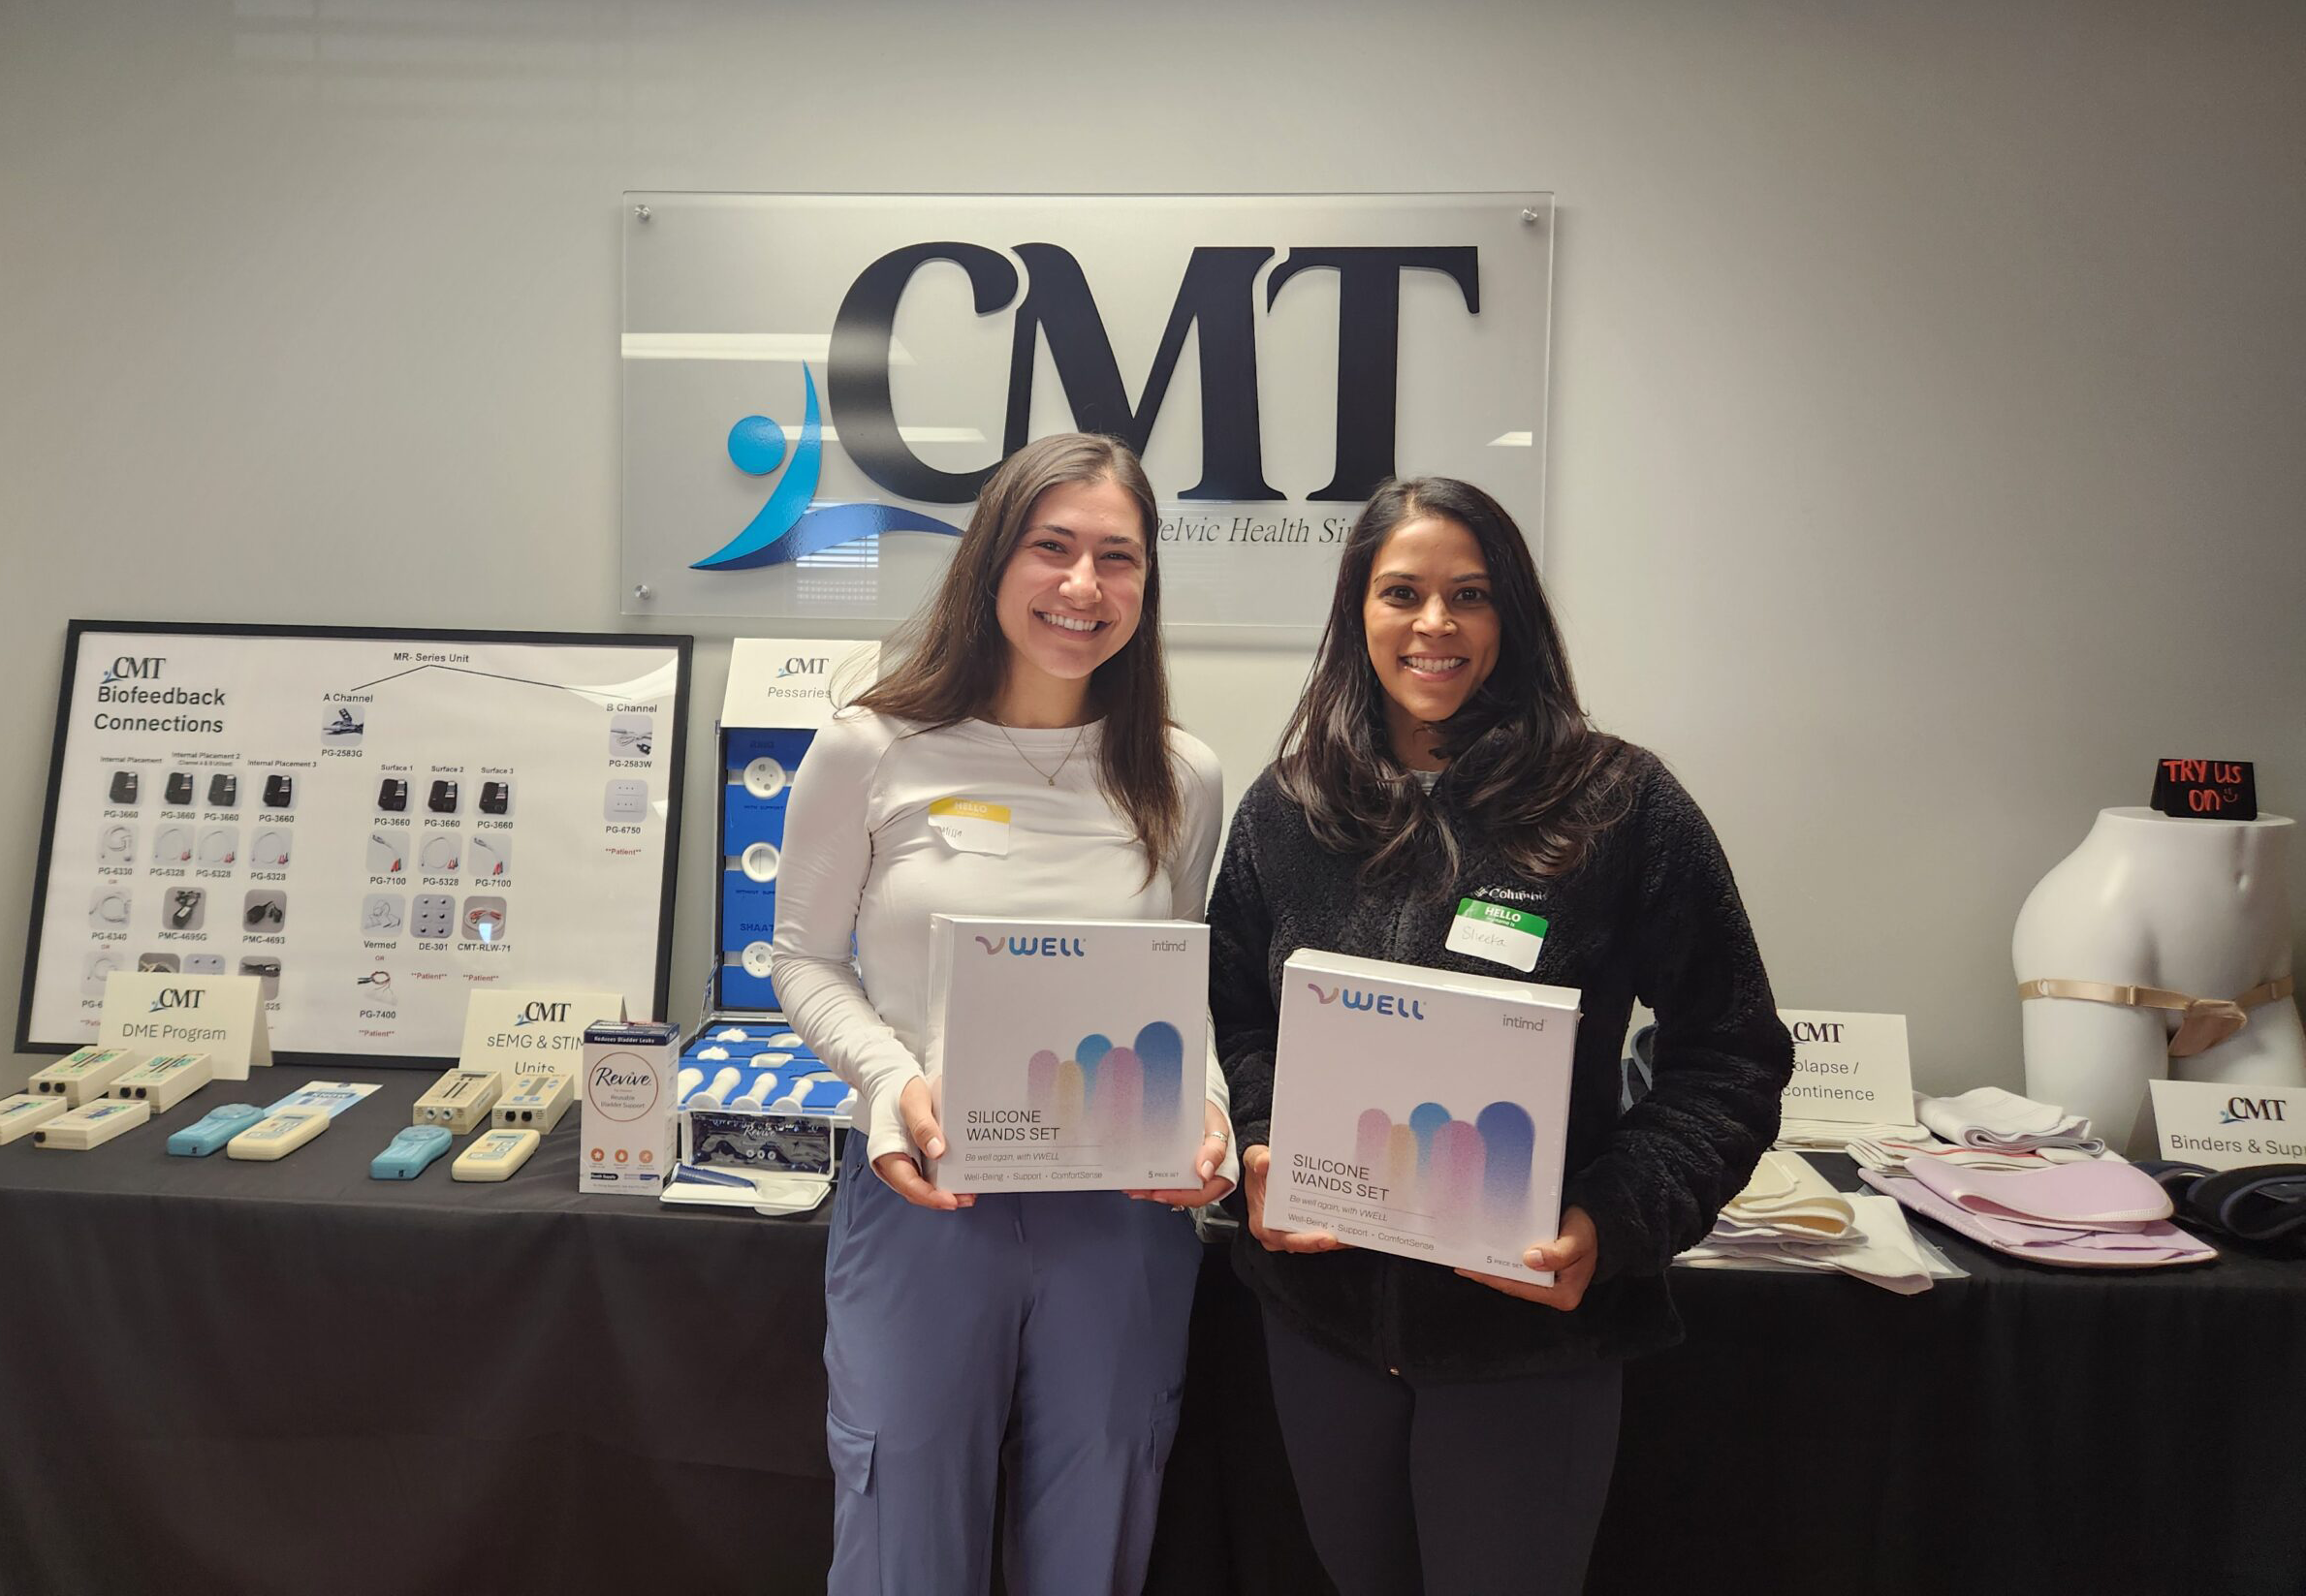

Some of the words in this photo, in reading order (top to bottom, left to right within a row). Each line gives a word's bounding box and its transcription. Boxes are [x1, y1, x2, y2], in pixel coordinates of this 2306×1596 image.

[827, 241, 1480, 502] CMT
[1227, 517, 1310, 543] Health
[1319, 517, 1352, 543] Si
[416, 653, 446, 663] Series
[449, 653, 469, 664] Unit
[785, 657, 830, 674] CMT
[112, 657, 166, 678] CMT
[97, 685, 226, 705] Biofeedback
[323, 693, 331, 703] A
[332, 693, 374, 704] Channel
[768, 686, 831, 699] Pessaries
[606, 704, 614, 712] B
[616, 704, 658, 713] Channel
[94, 713, 223, 733] Connections
[321, 749, 363, 759] PG-2583G
[609, 760, 652, 768] PG-2583W
[2162, 759, 2207, 783] TRY
[374, 818, 410, 827] PG-3660
[477, 821, 514, 829] PG-3660
[605, 826, 641, 834] PG-6750
[369, 876, 406, 886] PG-7100
[423, 877, 459, 887] PG-5328
[475, 879, 512, 888] PG-7100
[1484, 907, 1521, 923] HELLO
[975, 935, 1085, 956] VWELL
[1152, 939, 1186, 952] intimd
[159, 987, 205, 1009] CMT
[360, 1010, 396, 1018] PG-7400
[525, 1001, 572, 1022] CMT
[1308, 984, 1424, 1020] VWELL
[1502, 1015, 1544, 1032] intimd
[122, 1023, 159, 1038] DME
[162, 1024, 227, 1043] Program
[1793, 1021, 1845, 1043] CMT
[487, 1033, 532, 1048] sEMG
[536, 1035, 548, 1048] &
[515, 1061, 555, 1076] Units
[1794, 1059, 1848, 1075] olapse
[1853, 1062, 1859, 1075] /
[595, 1067, 651, 1086] Revive
[1783, 1085, 1875, 1101] continence
[2227, 1096, 2287, 1121] CMT
[967, 1110, 1041, 1124] SILICONE
[966, 1127, 1026, 1142] WANDS
[1029, 1127, 1060, 1141] SET
[2171, 1134, 2242, 1153] Binders
[2248, 1139, 2261, 1154] &
[2266, 1141, 2306, 1159] Sup
[977, 1152, 993, 1161] well
[1016, 1152, 1031, 1161] with
[1032, 1152, 1059, 1161] VWELL
[1293, 1154, 1370, 1181] SILICONE
[963, 1172, 1004, 1182] Well-Being
[1013, 1172, 1042, 1181] Support
[1051, 1171, 1103, 1180] ComfortSense
[1292, 1170, 1352, 1194] WANDS
[1356, 1184, 1390, 1201] SET
[1289, 1194, 1300, 1204] Be
[1301, 1198, 1317, 1207] well
[1342, 1205, 1357, 1215] with
[1359, 1209, 1387, 1222] VWELL
[1288, 1213, 1329, 1230] Well-Being
[1338, 1224, 1368, 1237] Support
[1377, 1233, 1435, 1251] ComfortSense
[1486, 1255, 1493, 1264] 5
